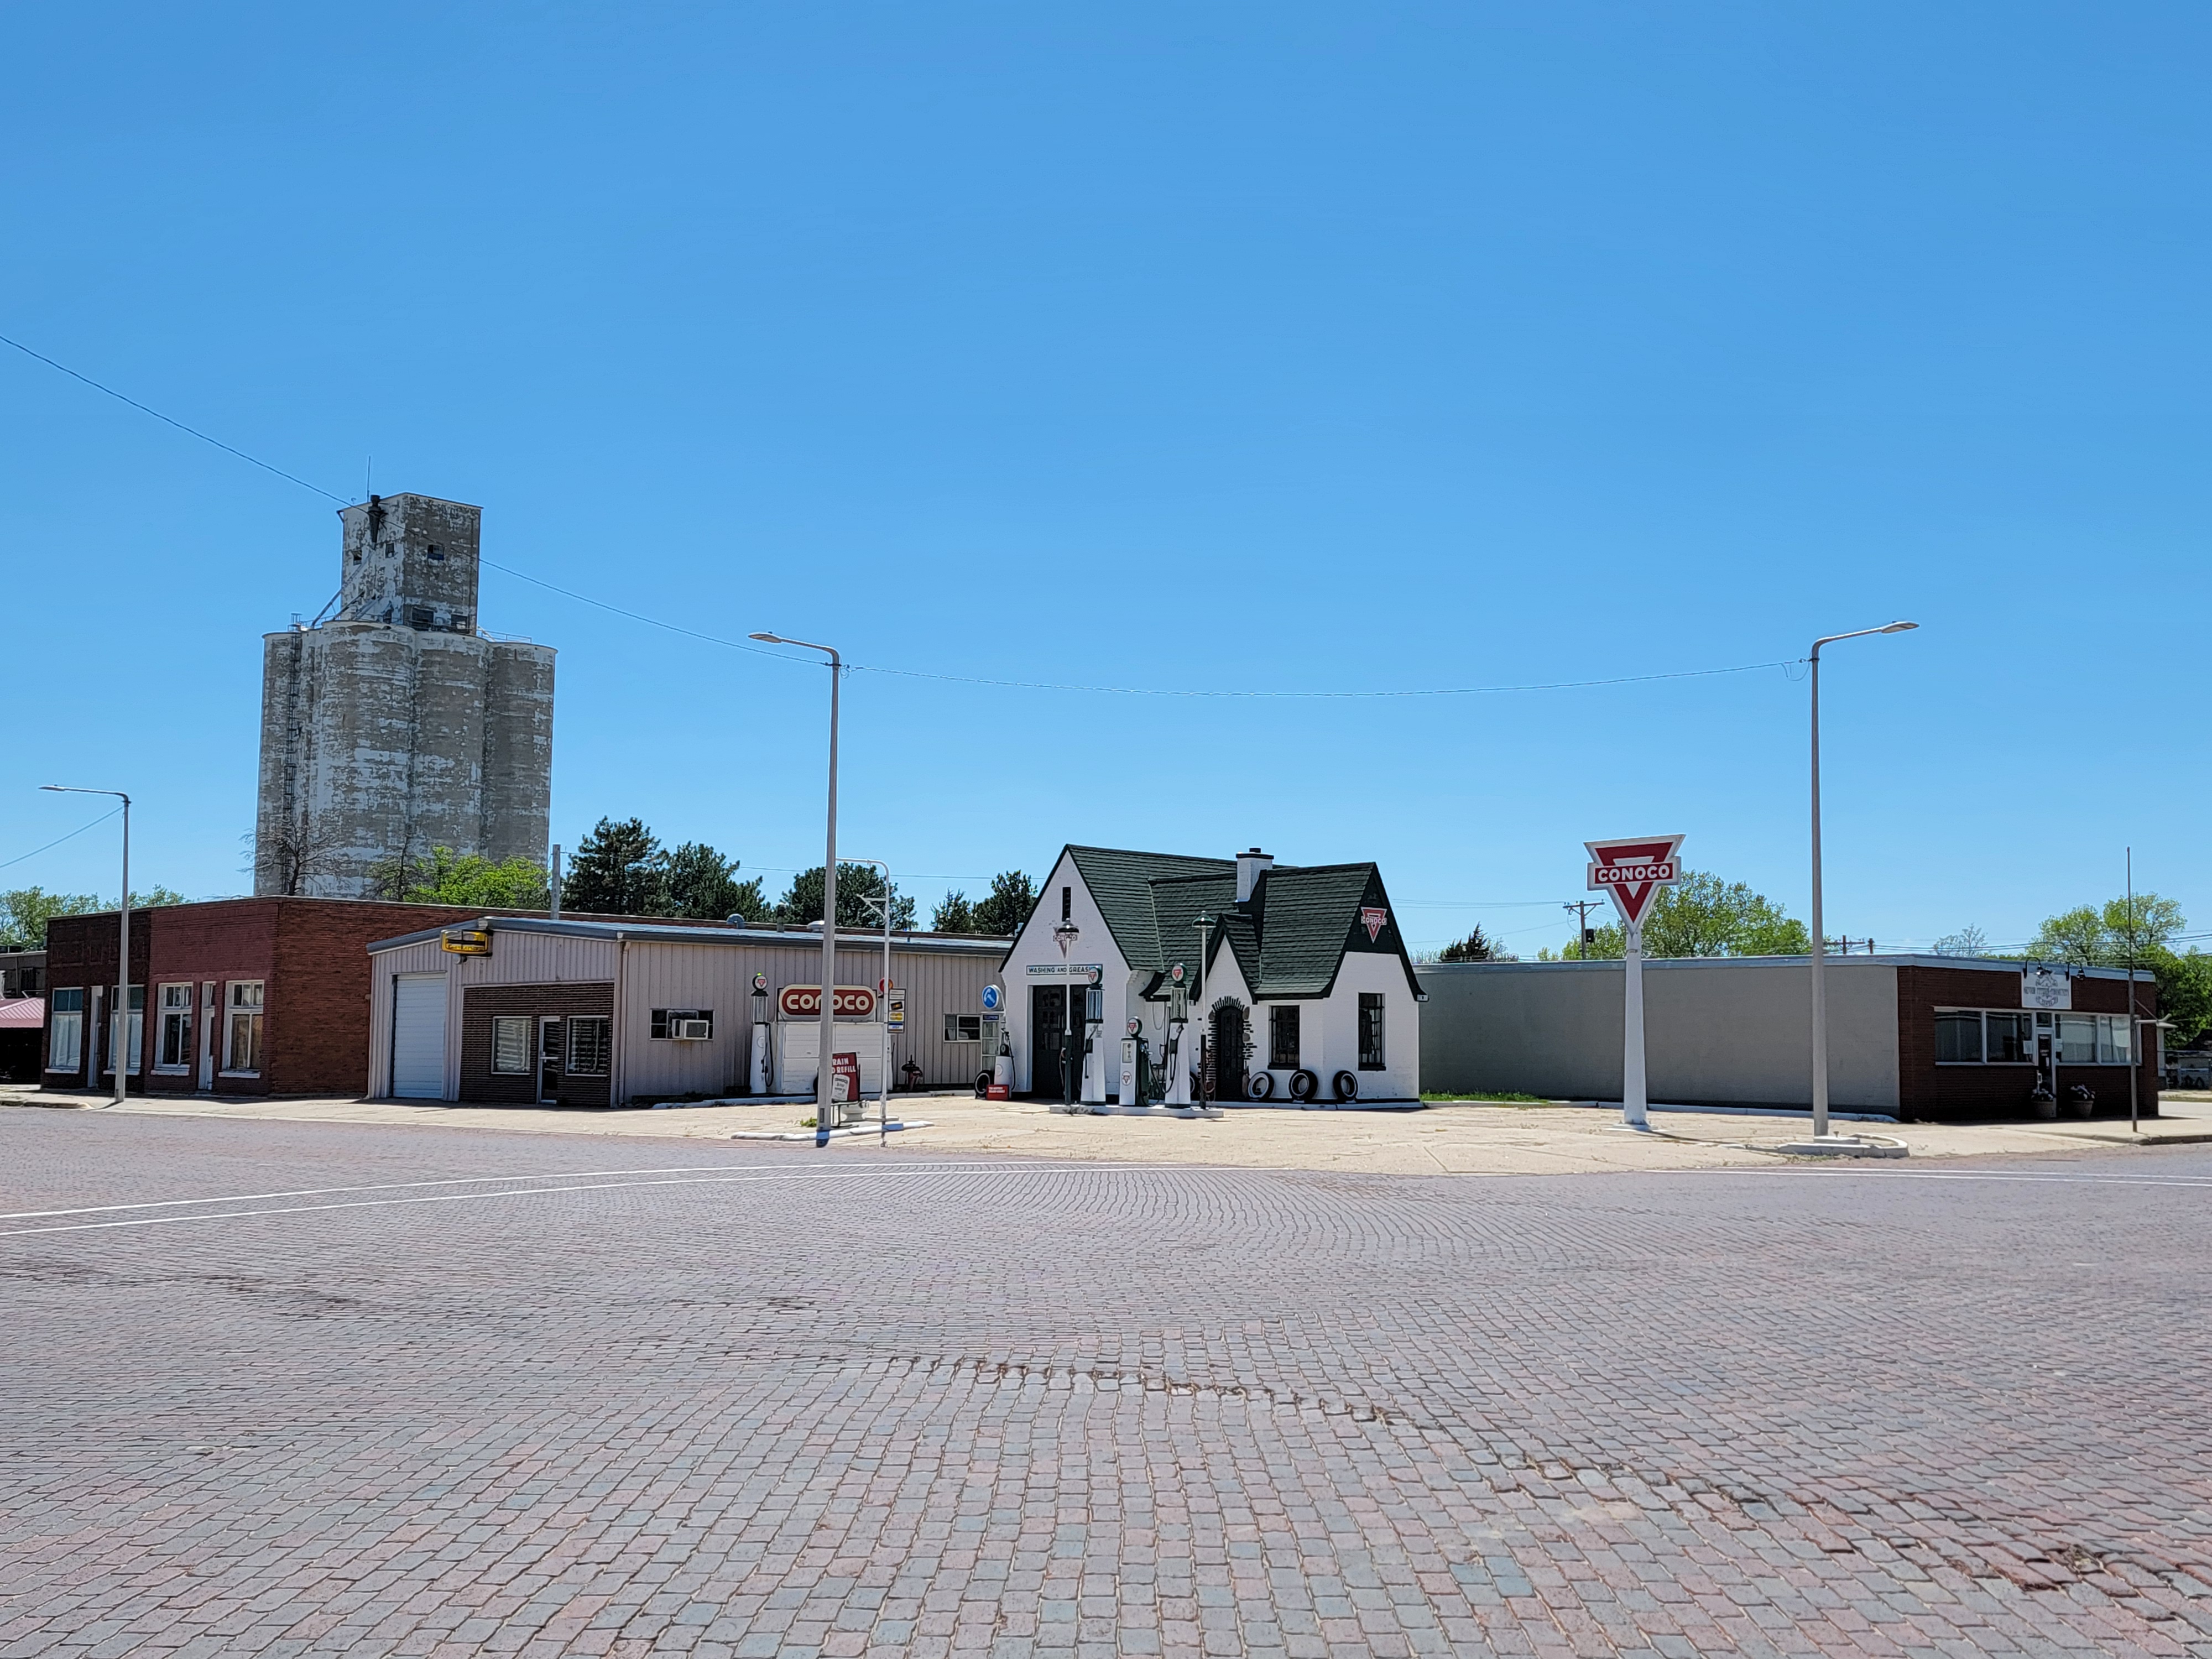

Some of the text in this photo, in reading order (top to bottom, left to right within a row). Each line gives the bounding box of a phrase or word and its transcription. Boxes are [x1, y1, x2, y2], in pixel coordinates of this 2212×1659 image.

[1598, 864, 1670, 881] CONOCO
[833, 1057, 849, 1066] RAIN
[837, 1065, 857, 1073] REFILL
